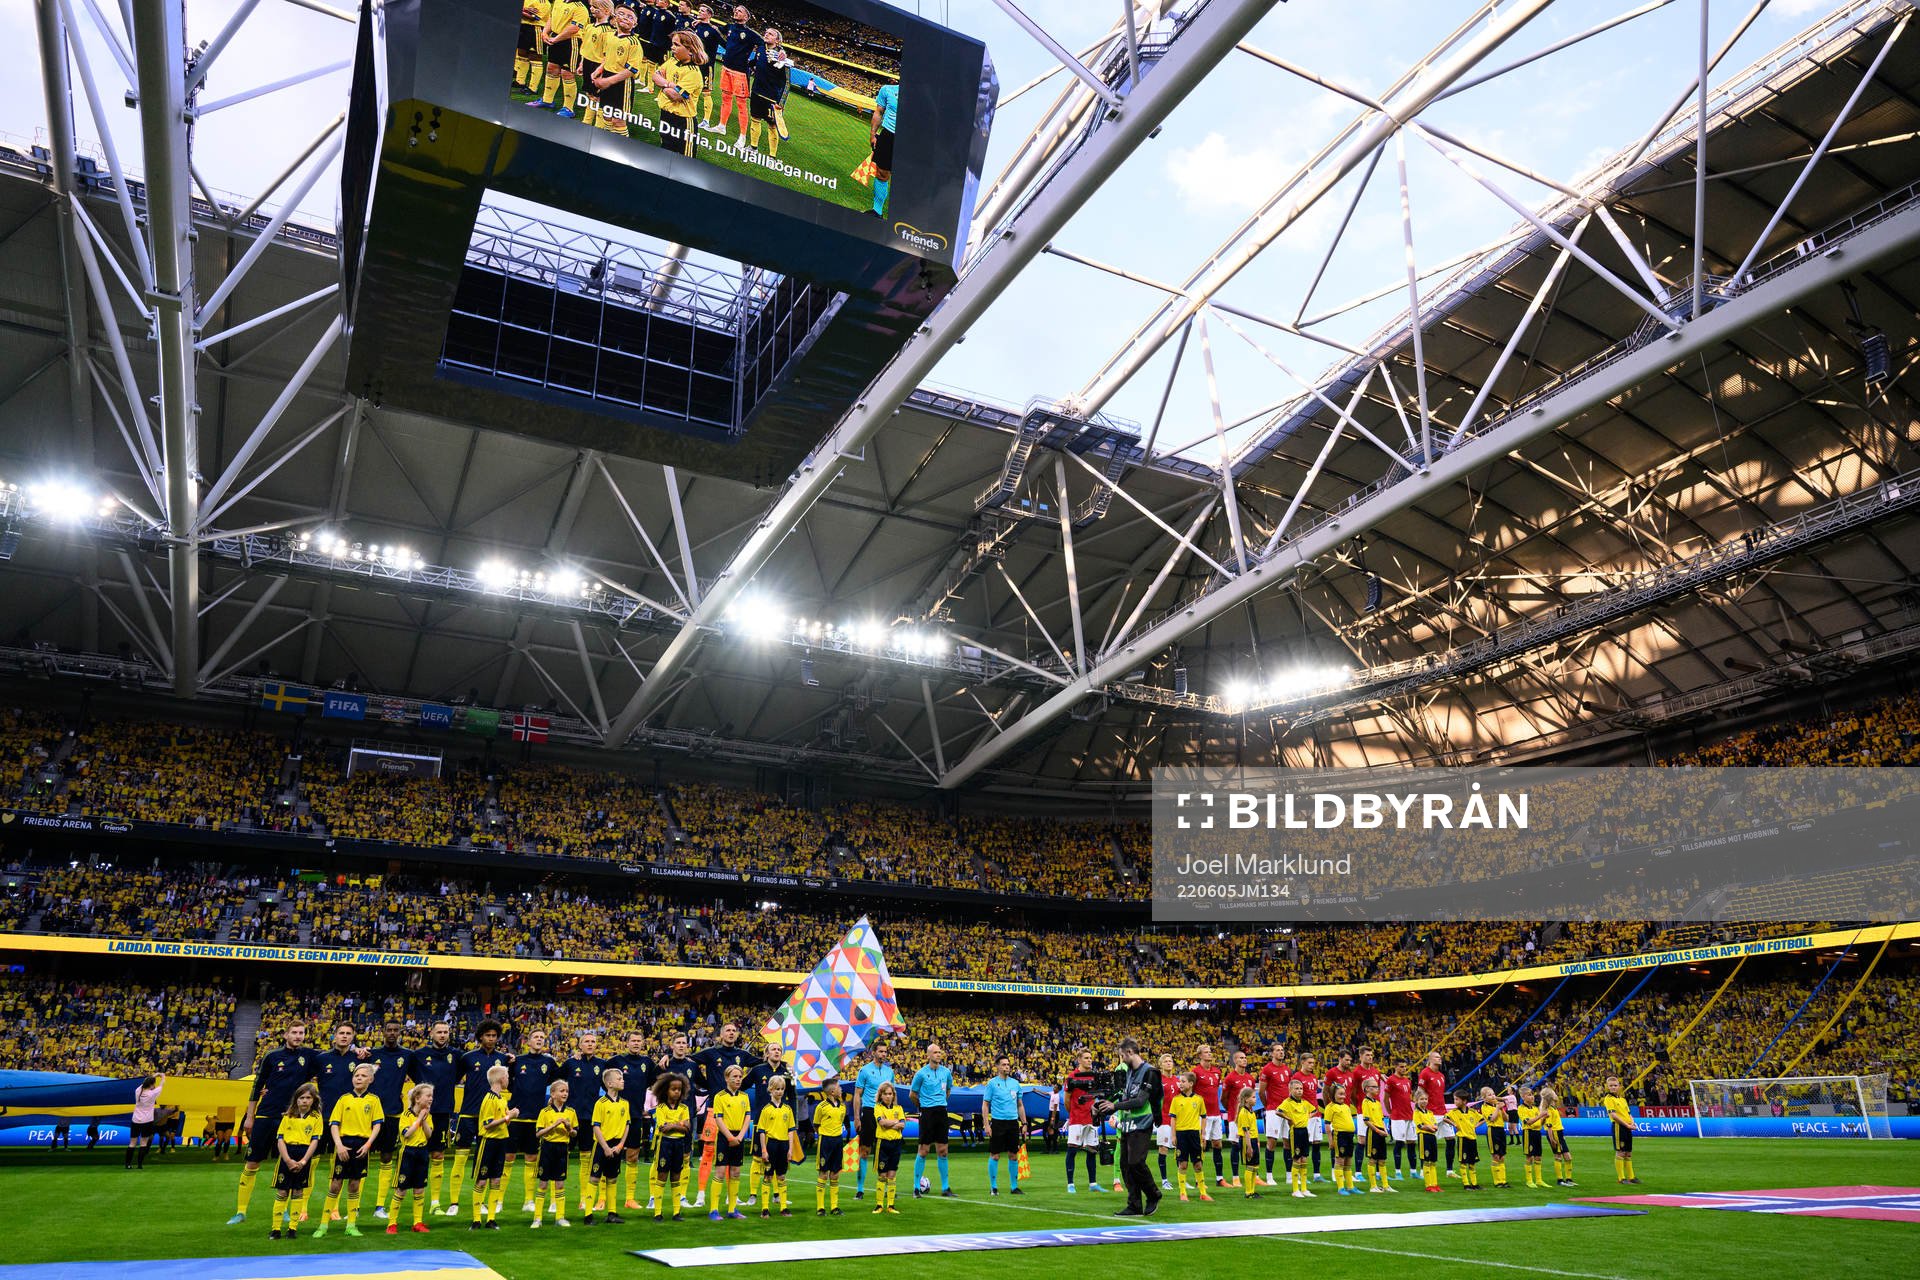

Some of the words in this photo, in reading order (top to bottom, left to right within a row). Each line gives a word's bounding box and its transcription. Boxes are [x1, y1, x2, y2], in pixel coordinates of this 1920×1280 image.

[577, 93, 598, 111] Du
[603, 104, 656, 131] gamla,
[659, 120, 679, 139] Du
[683, 130, 712, 150] fria,
[716, 139, 736, 157] Du
[804, 170, 837, 189] nord
[902, 229, 939, 250] friends
[329, 700, 359, 712] FIFA
[422, 711, 449, 723] UEFA
[381, 762, 409, 772] friends
[23, 816, 61, 827] FRIENDS
[63, 820, 92, 830] ARENA
[104, 824, 128, 832] friends
[1681, 837, 1727, 852] TILLSAMMANS
[1728, 835, 1742, 843] MOT
[1743, 828, 1779, 841] MOBBNING
[651, 868, 694, 878] TILLSAMMANS
[708, 872, 739, 881] MOBBNING
[753, 876, 778, 884] FRIENDS
[108, 941, 152, 953] LADDA
[155, 943, 180, 954] NER
[183, 945, 234, 957] SVENSK
[235, 947, 295, 960] FOTBOLLS
[297, 950, 328, 961] EGEN
[330, 952, 355, 962] APP
[356, 953, 381, 964] MIN
[382, 954, 429, 966] FOTBOLL
[1560, 964, 1588, 974] LADDA
[1589, 961, 1606, 971] NER
[1607, 958, 1643, 969] SVENSK
[1644, 951, 1691, 965] FOTBOLLS
[1692, 949, 1718, 960] EGEN
[1720, 945, 1741, 956] APP
[1744, 942, 1765, 954] MIN
[1767, 937, 1814, 952] FOTBOLL
[932, 980, 958, 989] LADDA
[960, 982, 975, 990] NER
[976, 983, 1007, 992] SVENSK
[1008, 984, 1044, 993] FOTBOLLS
[1045, 986, 1063, 994] EGEN
[1064, 986, 1079, 994] APP
[1080, 987, 1095, 996] MIN
[1096, 988, 1126, 997] FOTBOLL
[1792, 1122, 1829, 1133] PEACE
